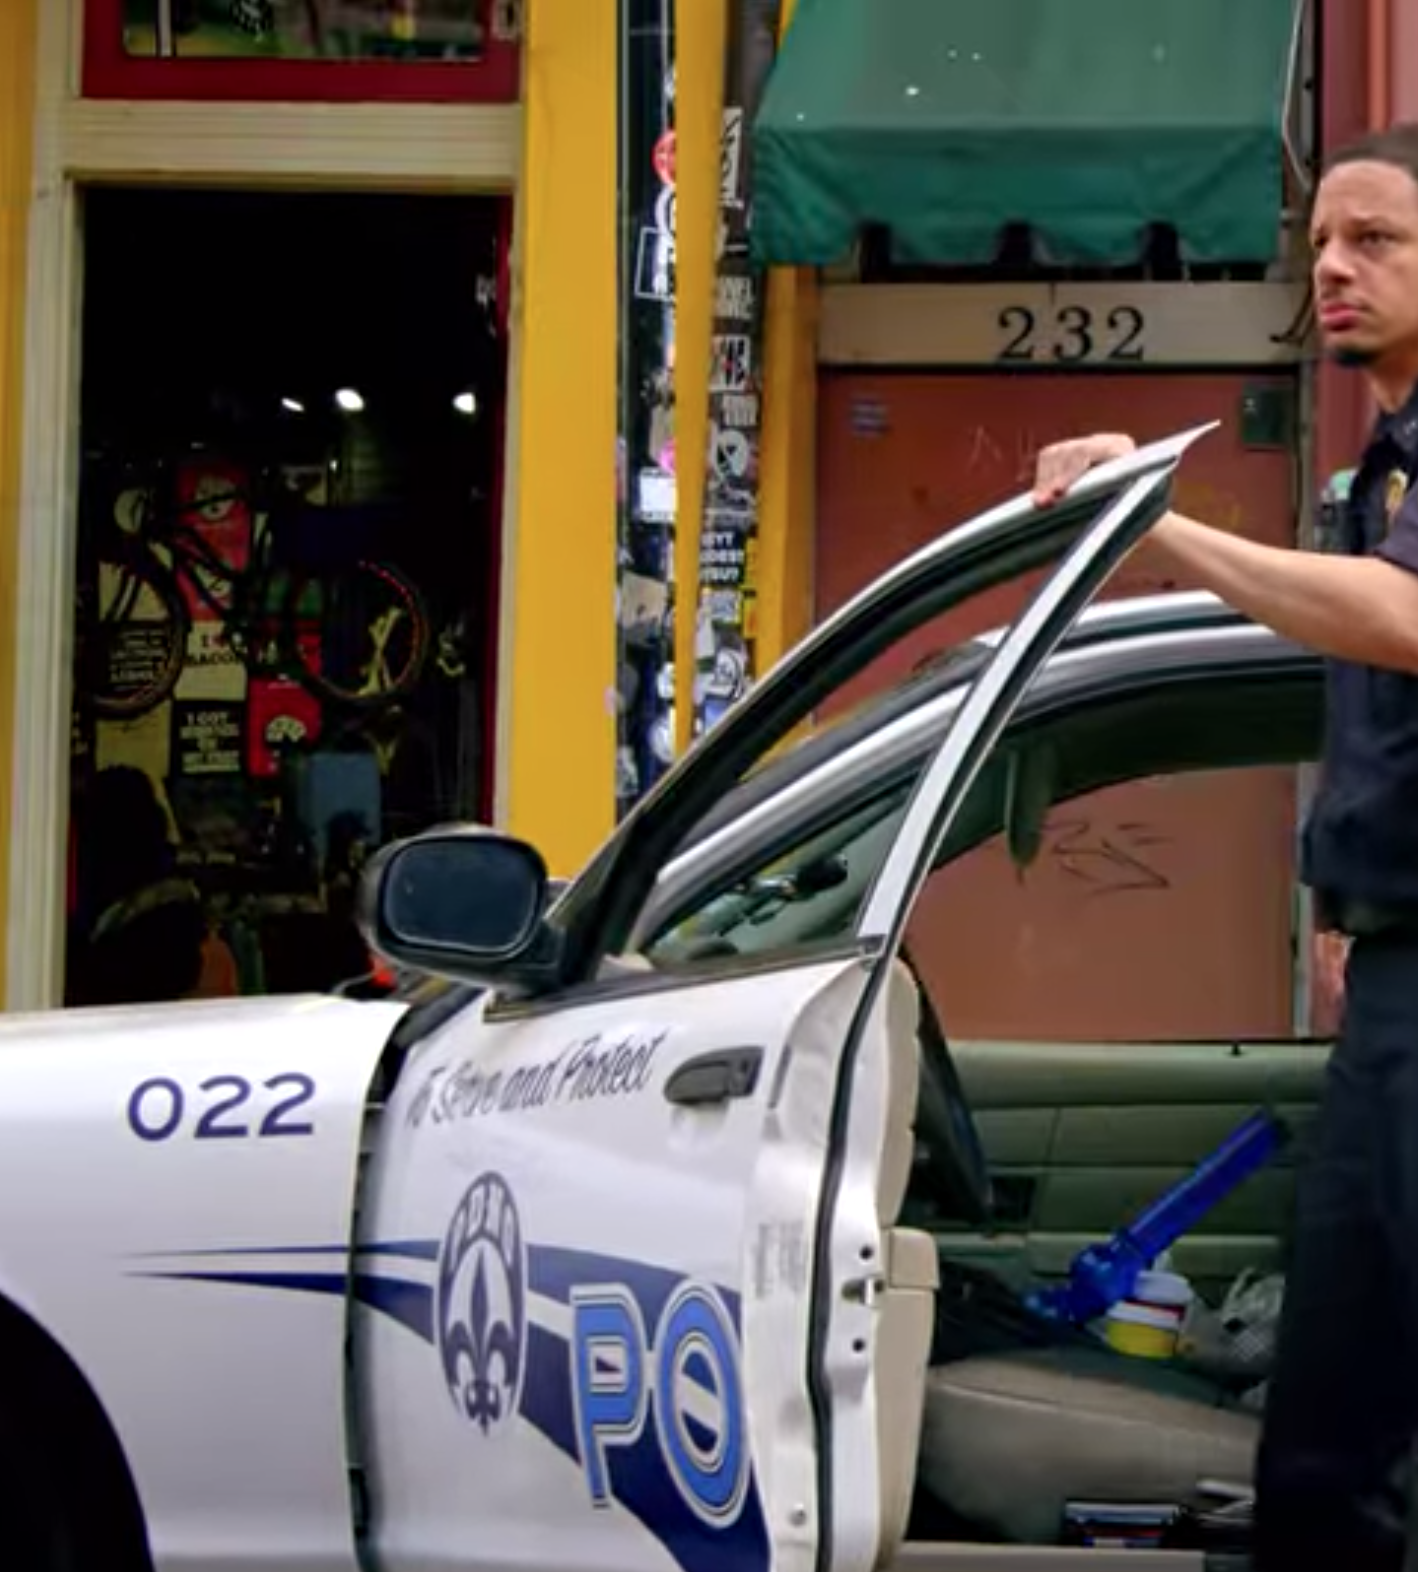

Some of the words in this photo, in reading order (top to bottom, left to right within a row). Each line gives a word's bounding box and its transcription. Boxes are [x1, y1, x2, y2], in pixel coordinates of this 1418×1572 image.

[998, 306, 1146, 362] 232
[127, 1072, 316, 1142] 022
[431, 1060, 503, 1124] Serve
[498, 1050, 562, 1112] and
[556, 1030, 667, 1102] Protect
